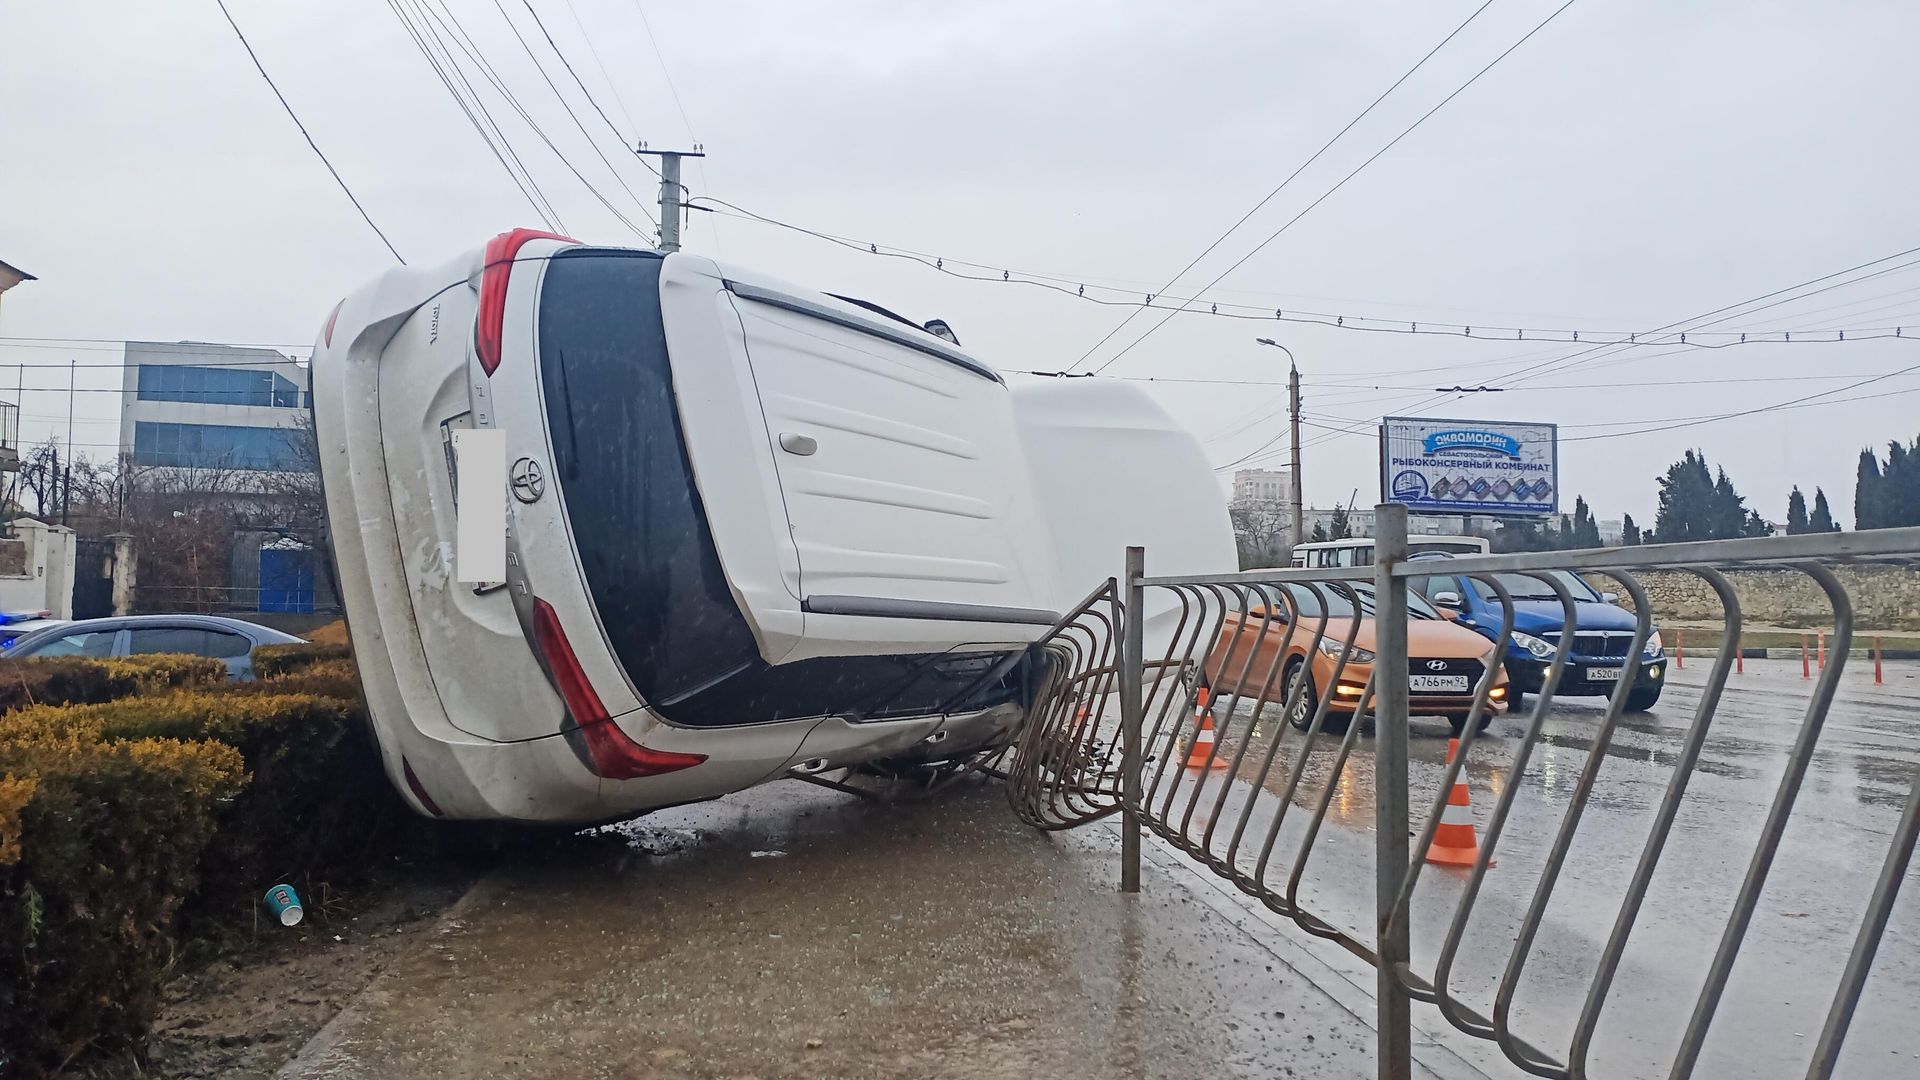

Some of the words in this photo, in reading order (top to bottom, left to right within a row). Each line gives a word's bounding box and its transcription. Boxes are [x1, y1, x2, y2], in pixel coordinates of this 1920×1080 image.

[429, 303, 440, 346] TOYOTA
[1392, 457, 1492, 469] РЫБОКОНСЕРВНЫЙ
[1495, 461, 1551, 472] КОМБИНАТ
